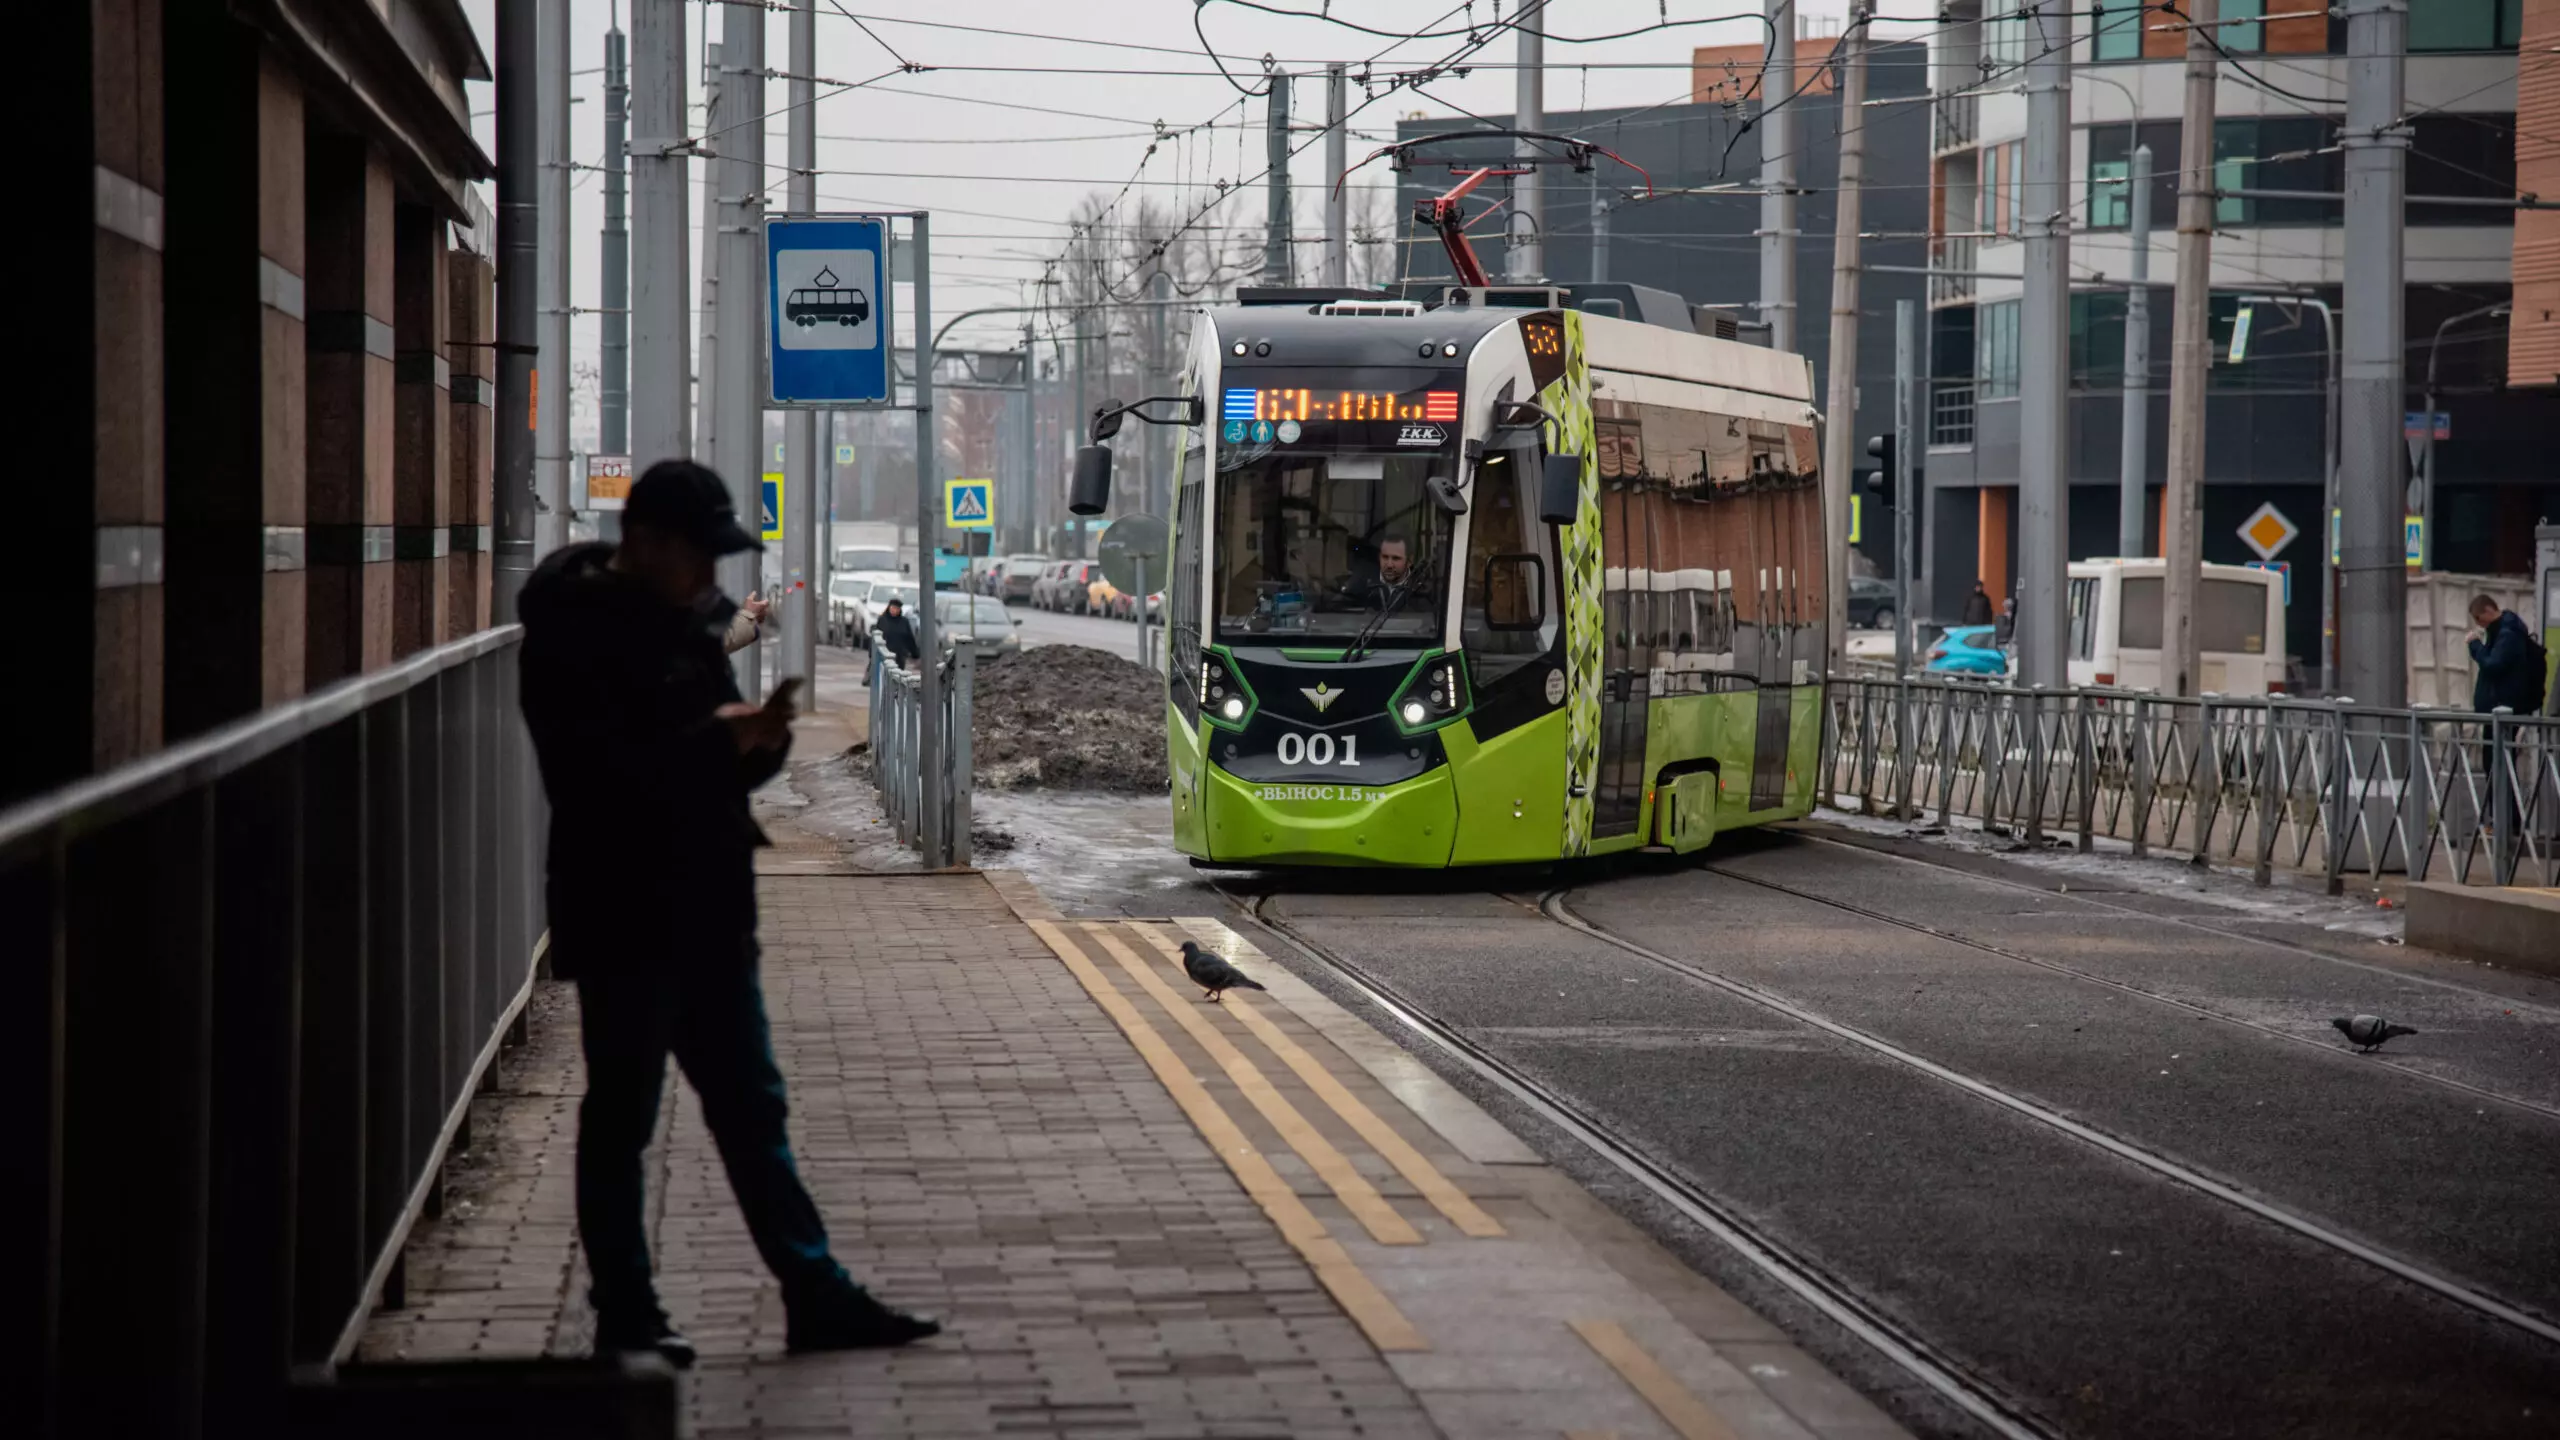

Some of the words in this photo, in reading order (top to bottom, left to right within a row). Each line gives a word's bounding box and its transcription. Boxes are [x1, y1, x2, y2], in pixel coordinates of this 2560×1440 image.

[1277, 732, 1361, 766] 001
[1263, 787, 1335, 802] ВЫНОС
[1337, 787, 1363, 802] 1.5
